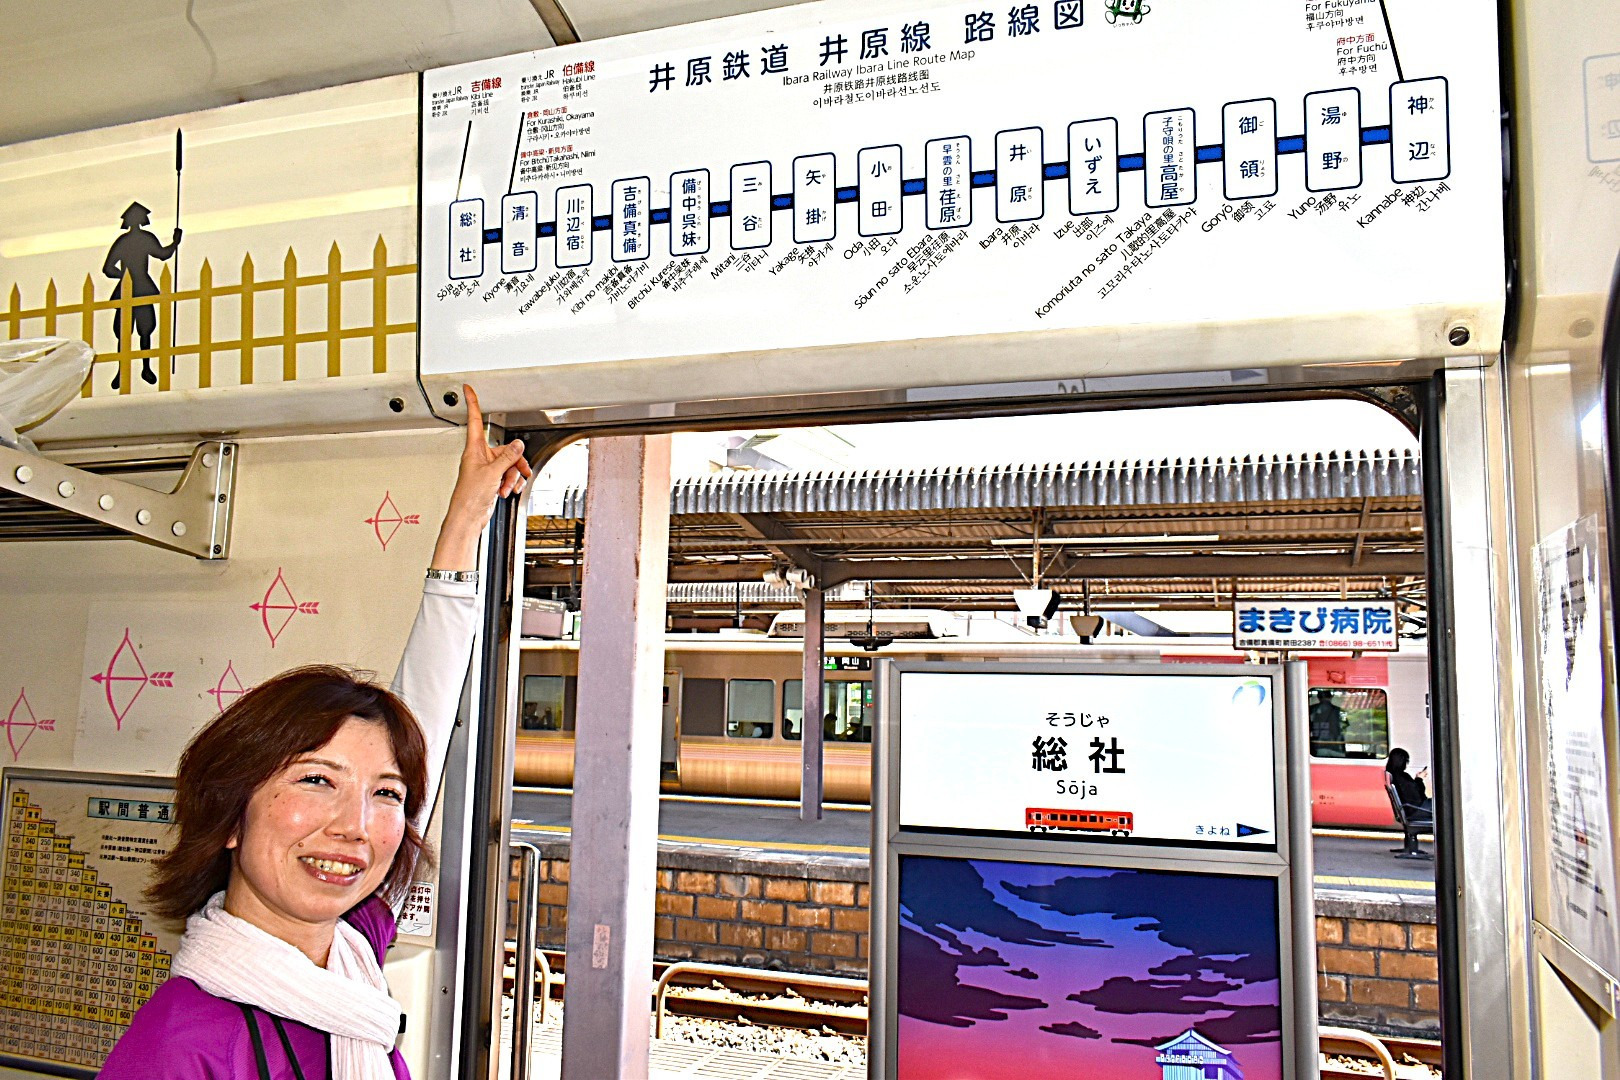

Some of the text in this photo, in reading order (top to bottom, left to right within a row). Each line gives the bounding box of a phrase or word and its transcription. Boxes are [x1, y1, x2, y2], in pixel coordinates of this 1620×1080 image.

[1305, 3, 1321, 12] For
[649, 0, 1084, 93] 井原鉄道 井原線 路線図
[1336, 32, 1375, 46] 府中方面
[1336, 47, 1353, 56] For
[544, 69, 555, 79] JR
[562, 60, 595, 77] 伯備線
[783, 50, 976, 86] Ibara Railway Ibara Line Route Map
[1337, 54, 1376, 66] 府中方向
[452, 86, 463, 96] JR
[471, 77, 502, 93] 吉備線
[583, 74, 596, 82] Line
[471, 92, 481, 101] Kibi
[482, 91, 494, 99] Line
[527, 119, 537, 127] For
[566, 111, 595, 122] Okayama
[1407, 95, 1430, 161] 神辺
[1238, 116, 1259, 179] 御領
[1321, 106, 1342, 170] 湯野
[520, 159, 530, 167] For
[1010, 143, 1027, 203] 井原
[1084, 137, 1102, 195] いずえ
[805, 169, 822, 226] 矢掛
[871, 160, 888, 217] 小田
[682, 178, 697, 248] 備中呉妹
[742, 177, 758, 232] 三谷
[1255, 200, 1277, 221] 고료
[1287, 195, 1317, 221] Yuno
[1314, 193, 1338, 216] 汤野
[1338, 193, 1362, 213] 유노
[1356, 188, 1404, 229] Kannabe
[512, 206, 525, 257] 清音
[567, 198, 580, 251] 川辺宿
[623, 186, 637, 253] 吉備真備
[1053, 219, 1074, 240] Izue
[1072, 216, 1094, 238] 出部
[1086, 214, 1115, 241] 이즈에
[460, 212, 473, 262] 総社
[863, 237, 881, 257] 小田
[880, 237, 899, 257] 오다
[979, 227, 1003, 251] Ibara
[1001, 224, 1022, 246] 井原
[1012, 222, 1041, 249] 이바라
[733, 251, 752, 272] 三谷
[745, 249, 769, 273] 미타니
[769, 247, 800, 277] Yakage
[843, 240, 864, 260] Oda
[875, 276, 889, 291] no
[889, 257, 908, 278] sato
[906, 234, 933, 261] Ebara
[650, 260, 677, 286] Kurese
[710, 251, 736, 280] Mitani
[1035, 212, 1152, 319] Komoriuta no sato Takaya
[482, 278, 507, 303] Kiyone
[518, 271, 561, 315] Kawabejuku
[571, 265, 619, 315] Kibi no makibi
[1238, 606, 1393, 634] まきび病院
[1045, 711, 1110, 729] そうじゃ
[1031, 736, 1126, 775] 総社
[1056, 779, 1098, 800] Sōja
[99, 801, 169, 820] 駅間普通
[1194, 823, 1231, 838] きよね
